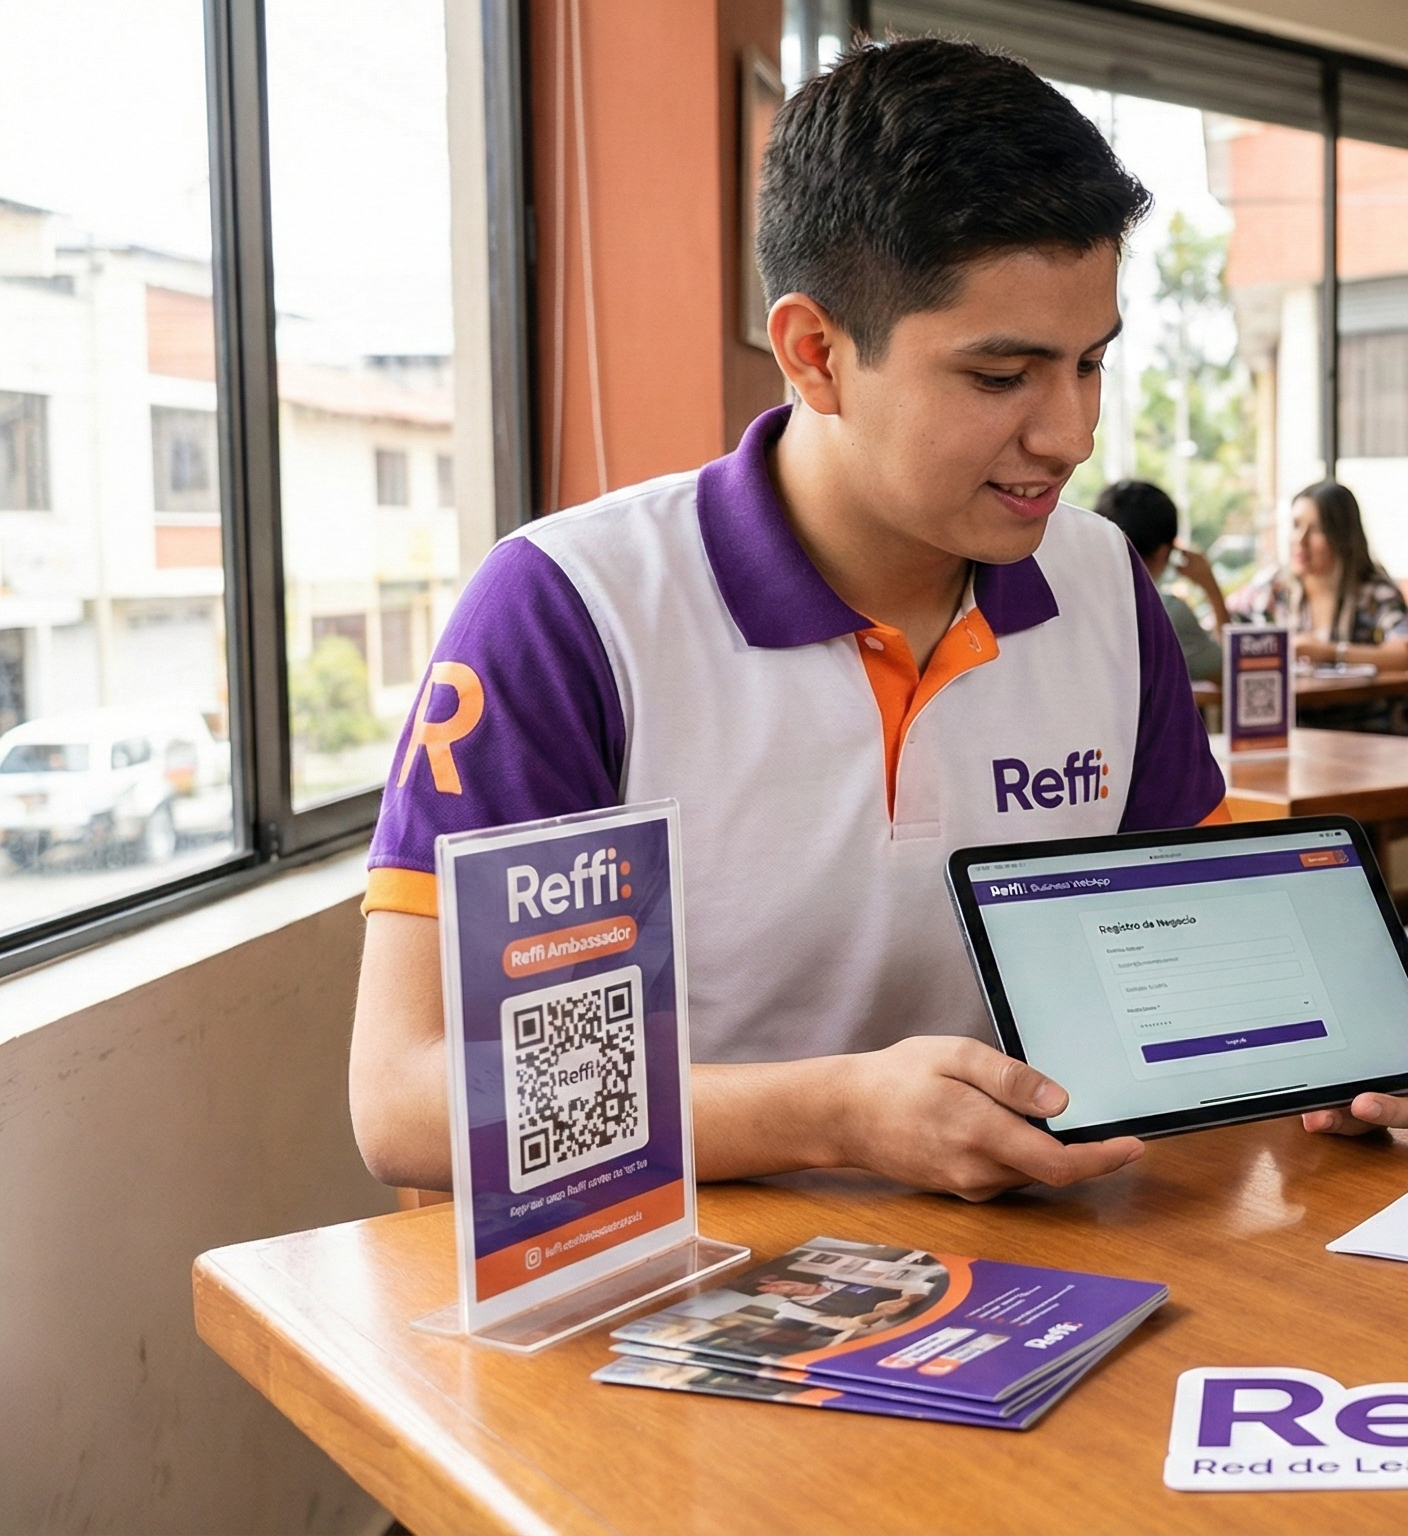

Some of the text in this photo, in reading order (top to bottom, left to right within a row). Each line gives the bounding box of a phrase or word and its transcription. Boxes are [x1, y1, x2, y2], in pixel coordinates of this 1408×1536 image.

[397, 660, 485, 796] R
[1099, 922, 1140, 935] Registro
[511, 926, 631, 967] Reffi Ambassador
[1192, 1458, 1274, 1475] Red
[1288, 1458, 1341, 1474] de
